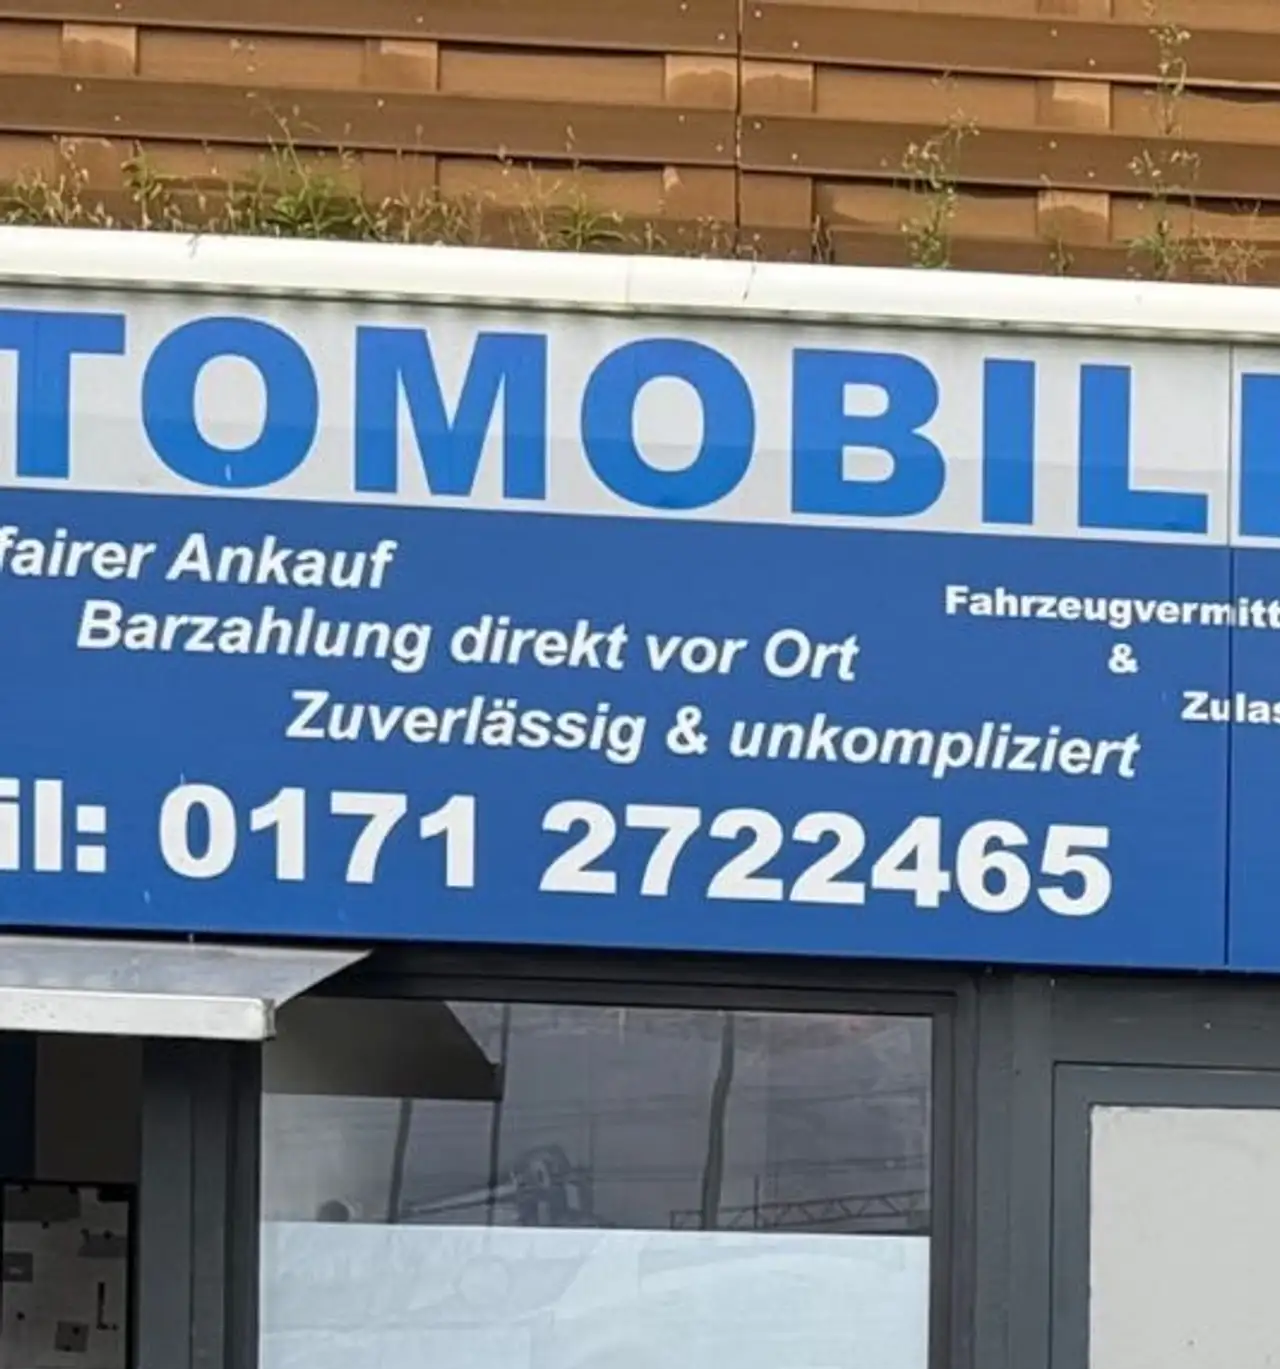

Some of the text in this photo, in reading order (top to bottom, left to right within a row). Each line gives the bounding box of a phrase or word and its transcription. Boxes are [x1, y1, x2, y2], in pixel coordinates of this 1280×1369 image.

[165, 532, 399, 589] Ankauf
[76, 598, 860, 682] Barzahlung direkt vor Ort
[1107, 642, 1139, 675] &
[285, 689, 1141, 780] Zuverlässig & unkompliziert
[159, 782, 475, 888] 0171
[539, 800, 1112, 917] 2722465
